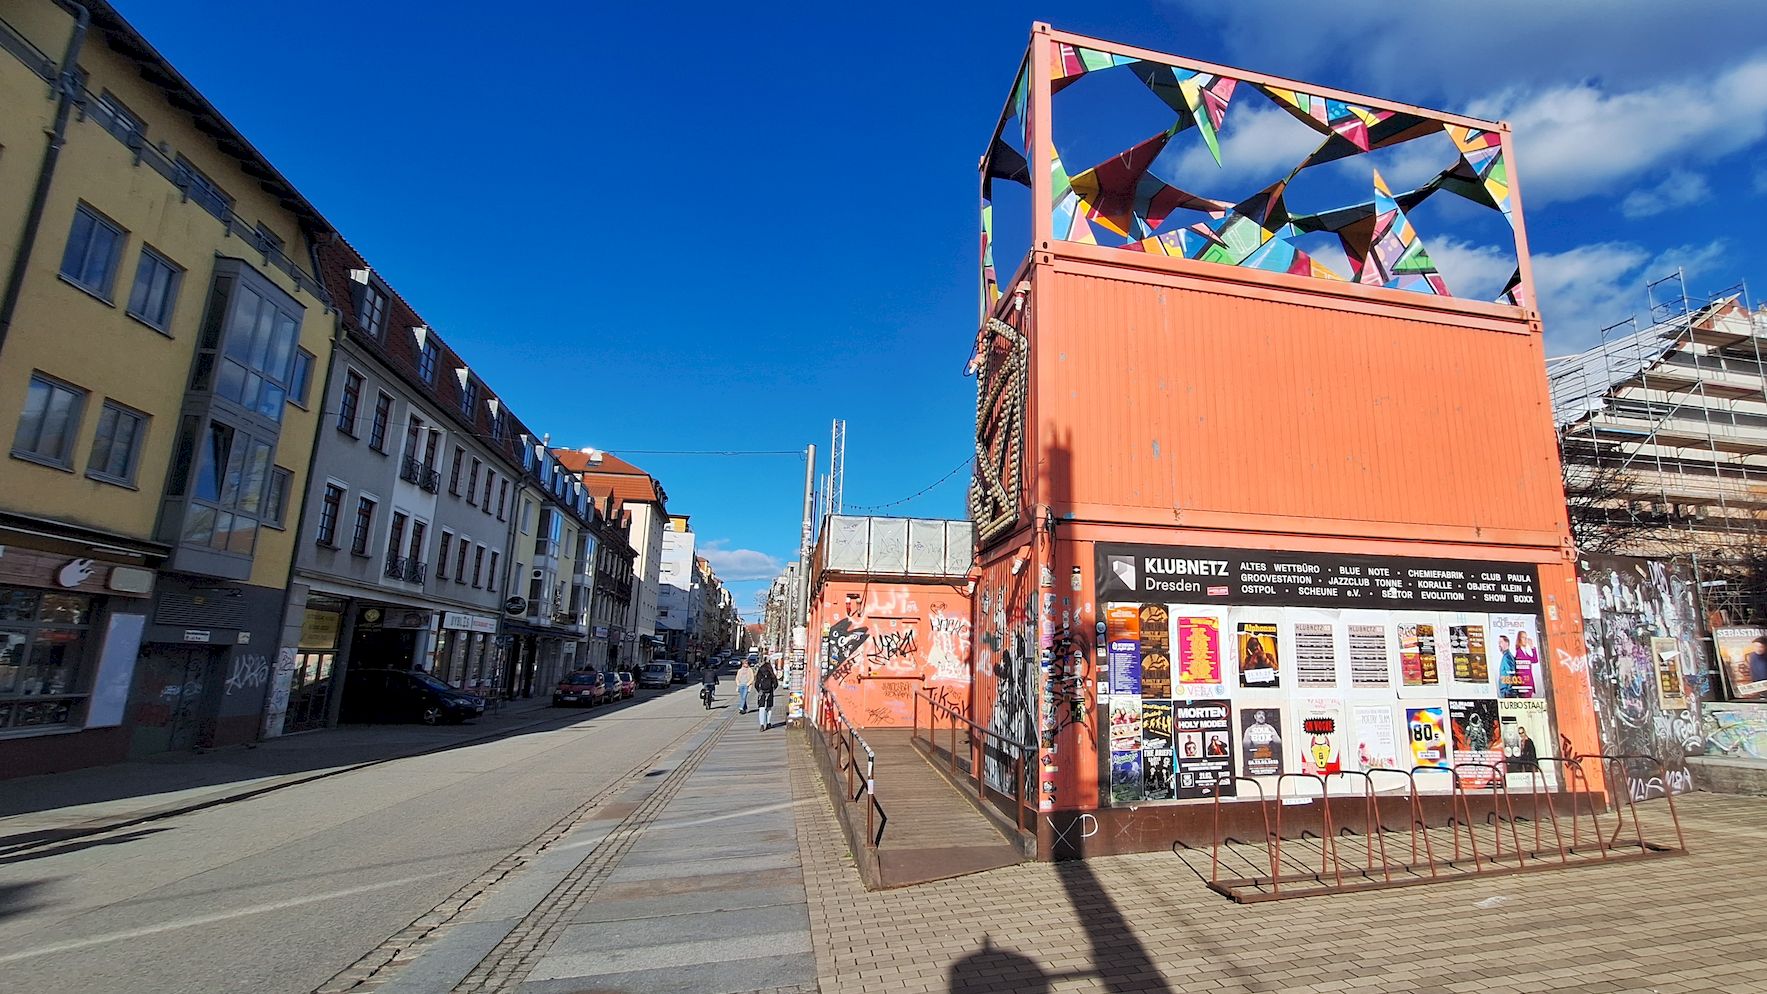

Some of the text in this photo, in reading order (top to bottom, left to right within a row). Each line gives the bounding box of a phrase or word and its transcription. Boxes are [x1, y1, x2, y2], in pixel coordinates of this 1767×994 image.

[1145, 558, 1229, 576] KLUBNETZ
[1240, 562, 1531, 582] ALTES WETTBÜRO BLUE NOTE CHEMIEFABRIK CLUB PAULA
[1146, 578, 1200, 592] Dresden
[1240, 574, 1532, 593] GROOVESTATION JAZZCLUB TONNE KORALLE OBJEKT KLEIN A
[1241, 585, 1276, 595] OSTPOL
[1298, 587, 1338, 597] SCHEUNE
[1346, 588, 1360, 598] e.V.
[1421, 591, 1464, 600] EVOLUTION
[1484, 594, 1506, 602] SHOW
[1514, 594, 1534, 603] BOXX
[1178, 707, 1226, 718] MORTEN
[1178, 720, 1228, 728] HOLY MODEE
